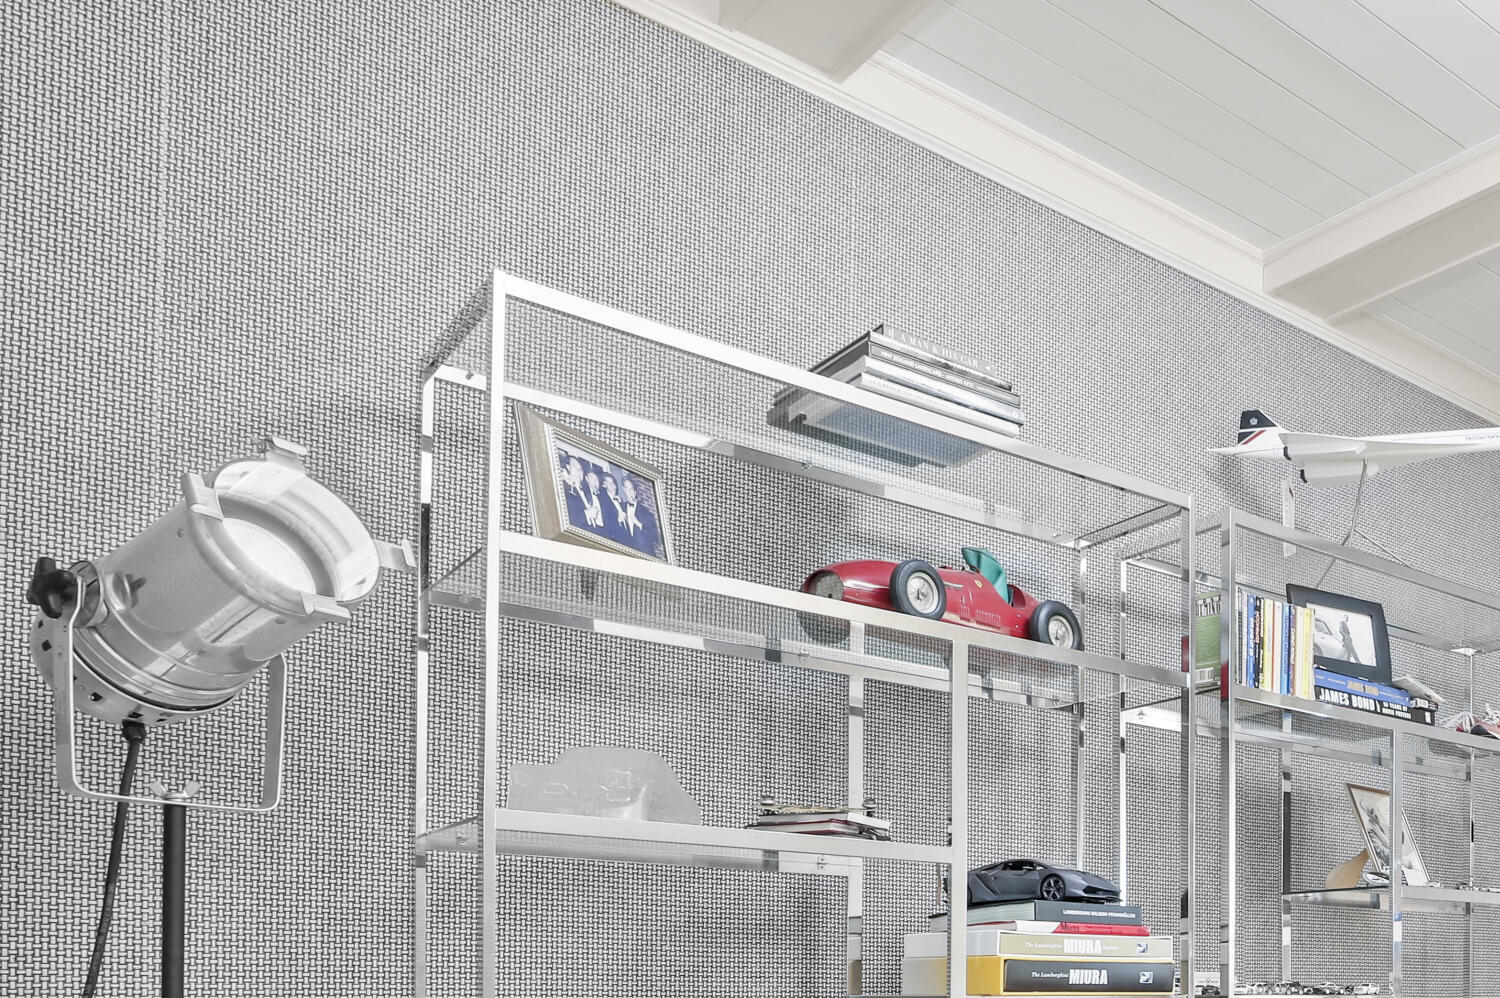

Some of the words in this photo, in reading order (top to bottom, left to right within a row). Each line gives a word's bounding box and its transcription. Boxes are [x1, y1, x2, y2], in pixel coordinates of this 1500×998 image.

[1319, 688, 1349, 706] JAMES
[1351, 695, 1375, 712] BOND
[1063, 939, 1102, 954] MIURA
[1068, 969, 1109, 985] MIURA
